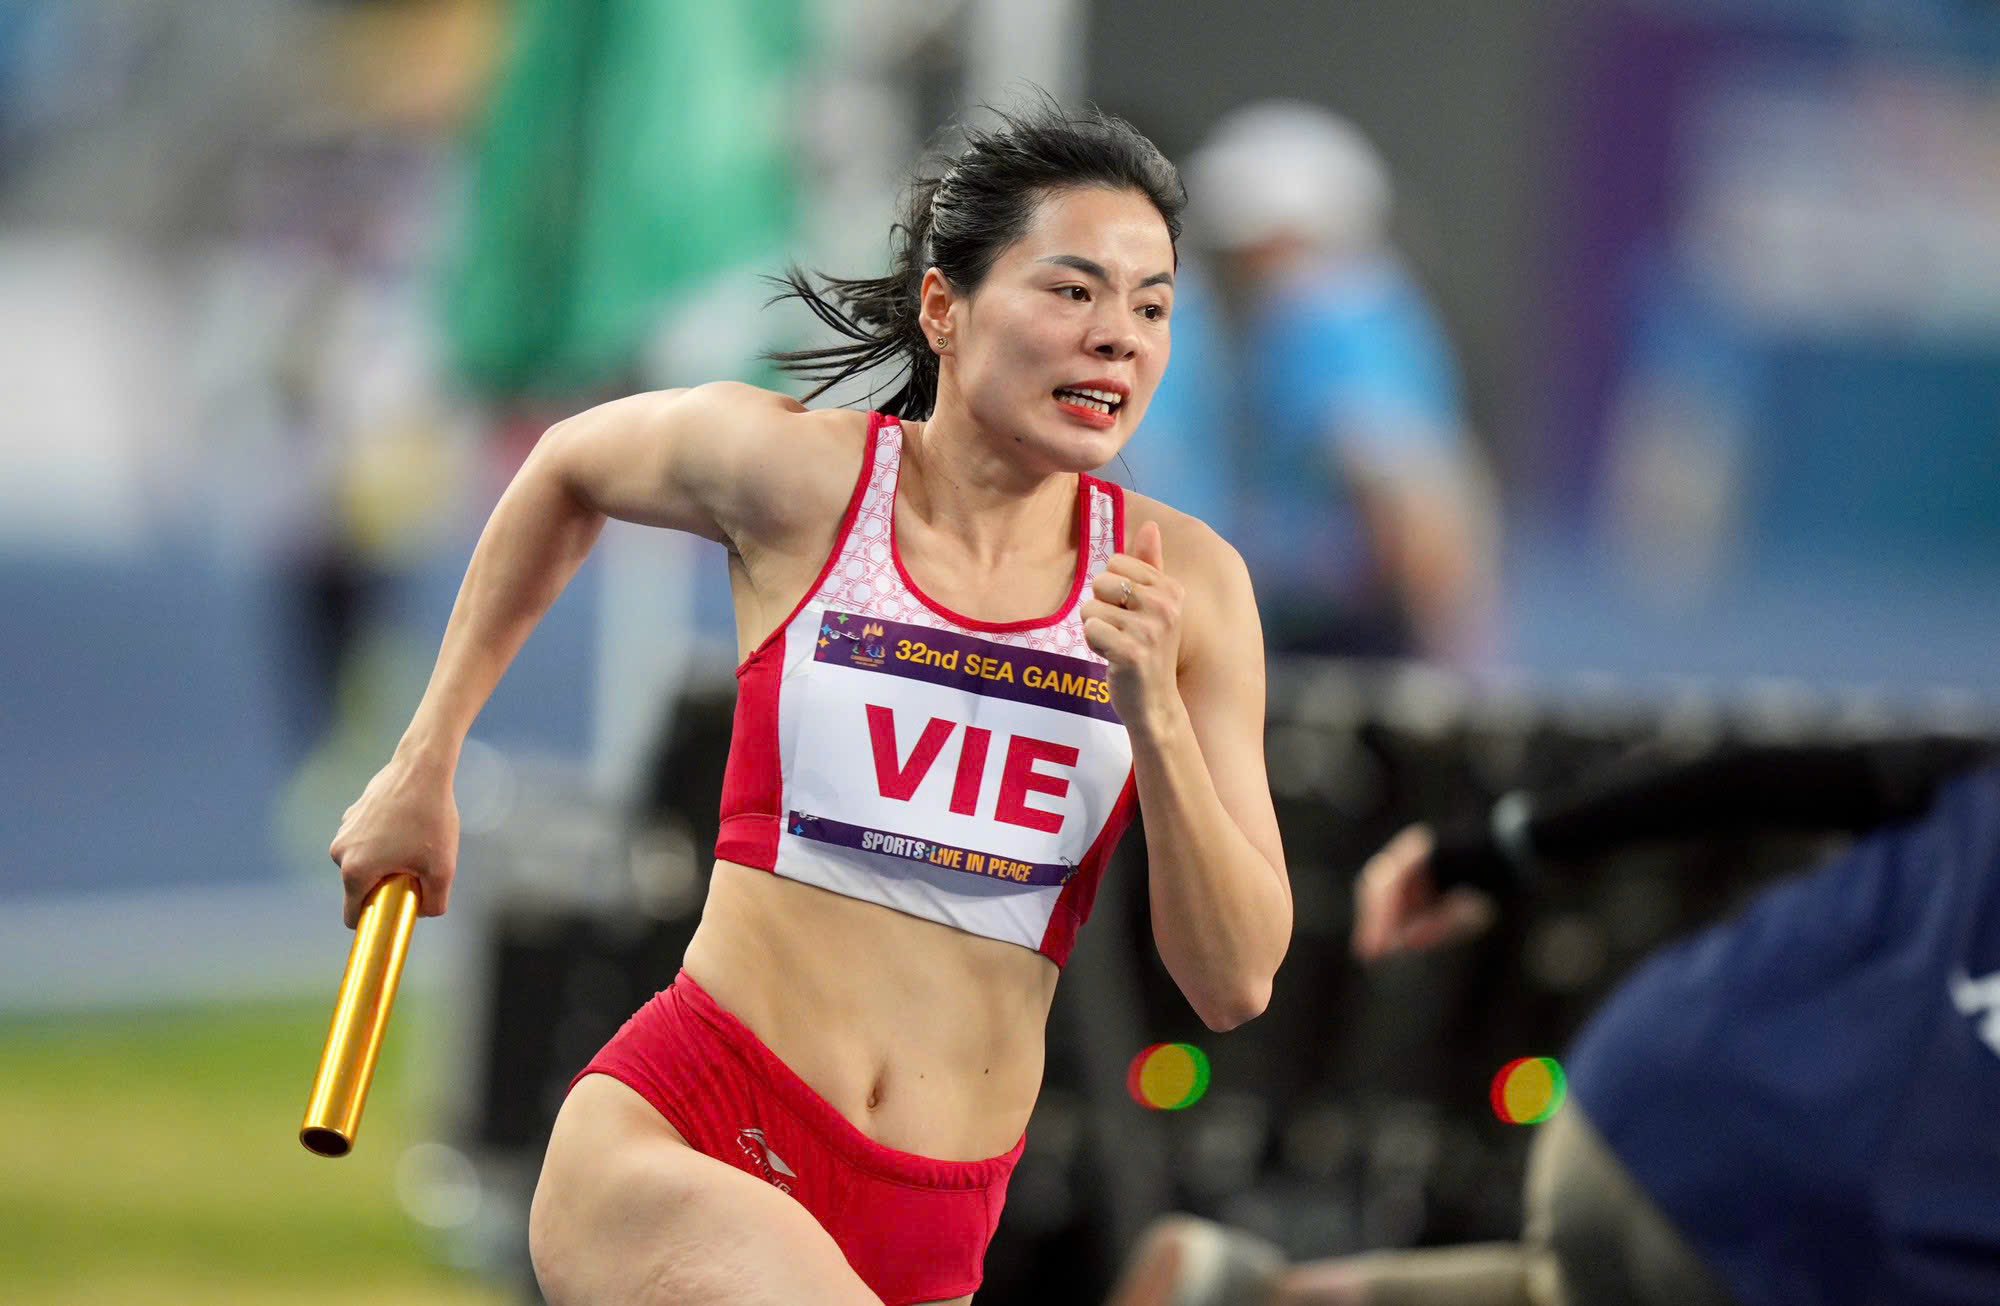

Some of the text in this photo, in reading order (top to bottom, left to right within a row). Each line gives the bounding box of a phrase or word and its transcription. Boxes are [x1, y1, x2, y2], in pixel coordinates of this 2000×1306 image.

[895, 639, 1111, 704] 32nd SEA GAMES
[865, 703, 1081, 835] VIE
[930, 845, 963, 869] LIVE
[965, 852, 986, 873] IN
[988, 857, 1033, 882] PEACE
